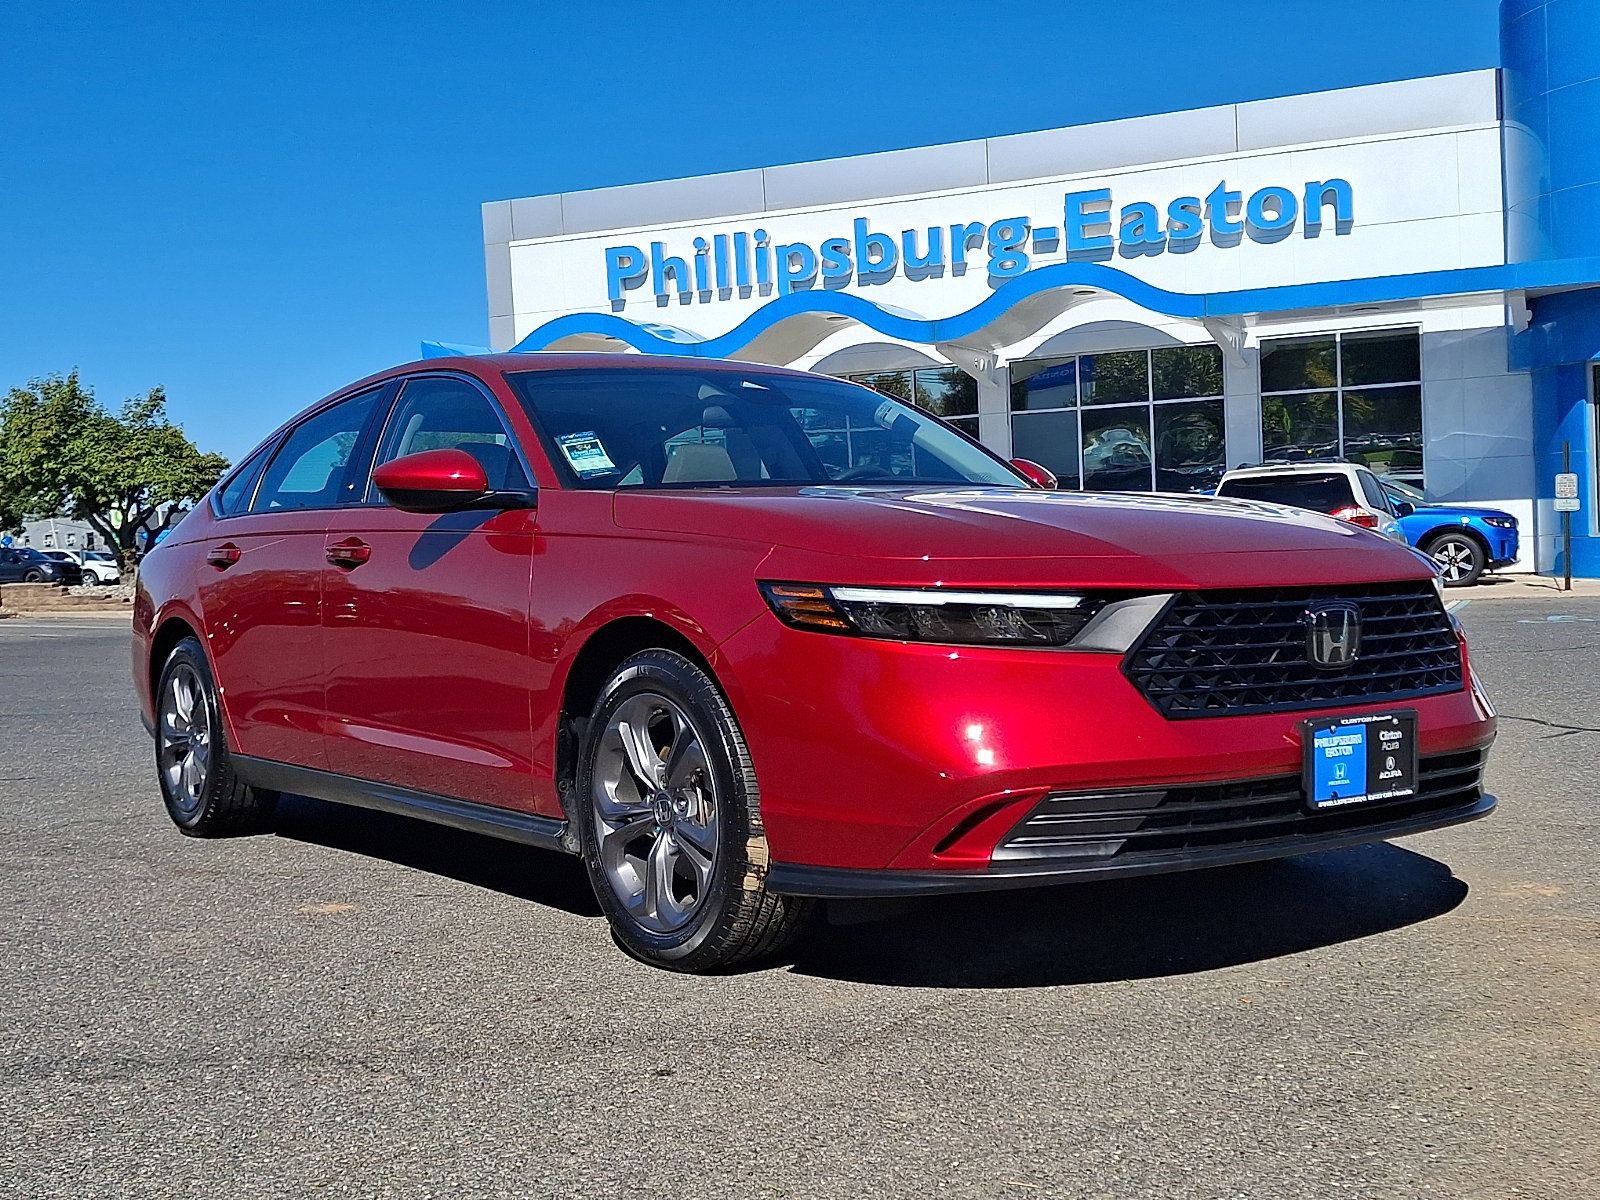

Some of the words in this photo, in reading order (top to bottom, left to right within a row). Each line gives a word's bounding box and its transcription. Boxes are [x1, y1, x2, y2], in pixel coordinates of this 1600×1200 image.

[604, 177, 1354, 302] Phillipsburg-Easton
[1381, 741, 1400, 751] Acura
[1378, 769, 1403, 779] ACURA
